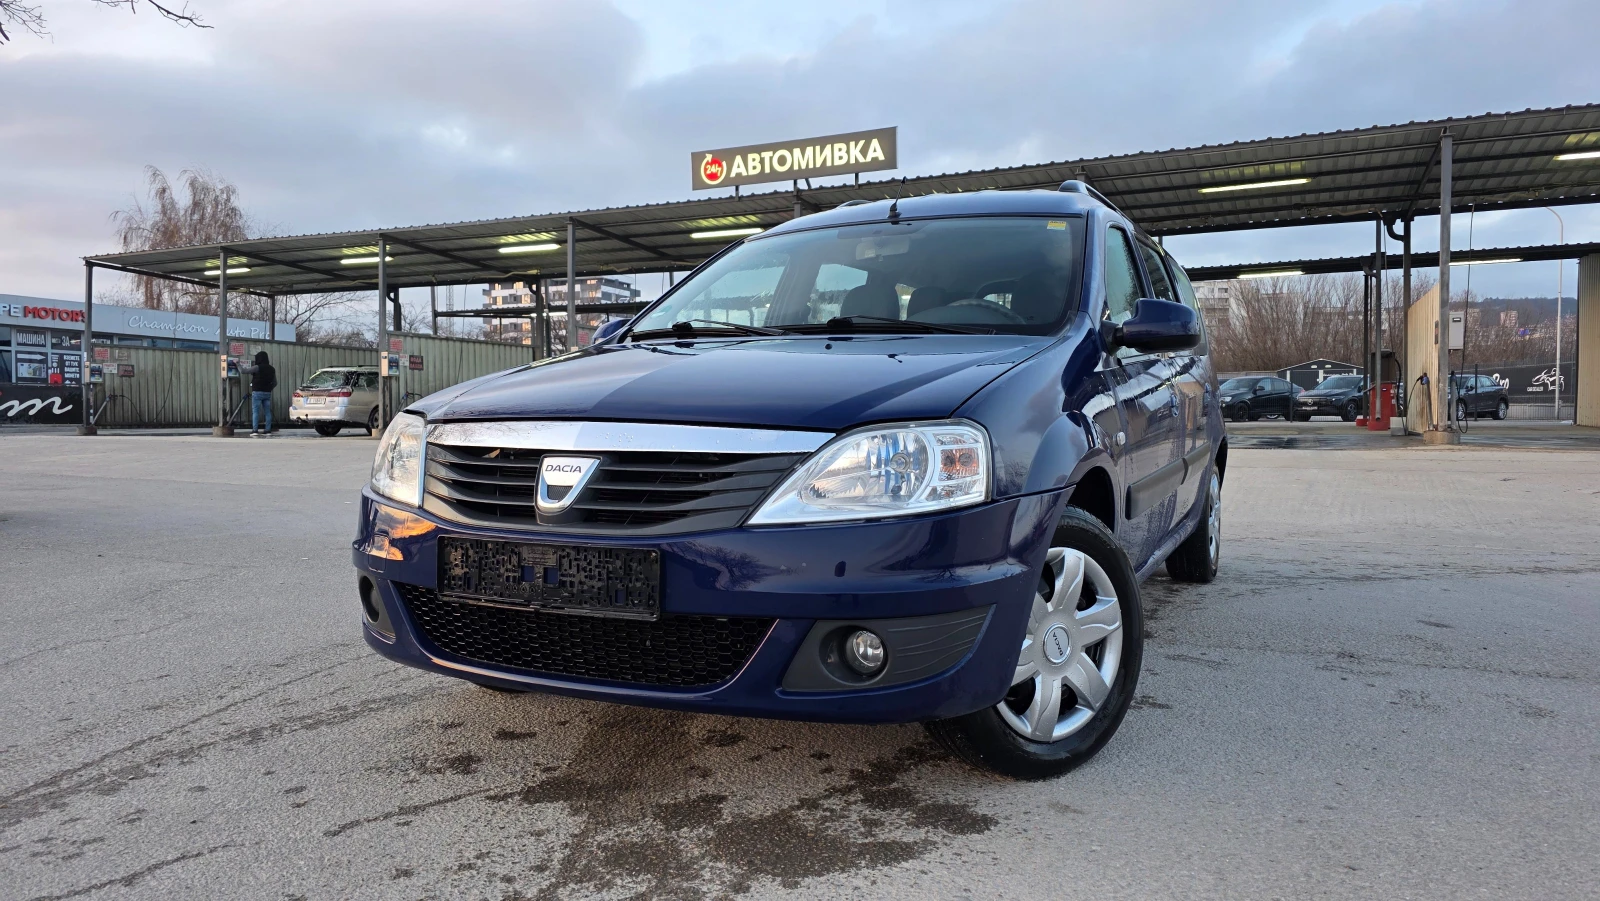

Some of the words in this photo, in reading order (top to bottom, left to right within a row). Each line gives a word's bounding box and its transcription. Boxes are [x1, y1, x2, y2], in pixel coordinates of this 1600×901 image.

[730, 138, 886, 178] АВТОМИВКА
[17, 332, 46, 345] МАШИНА
[61, 335, 70, 347] ЗА
[545, 464, 582, 473] DACIA
[1053, 632, 1063, 655] DACIA
